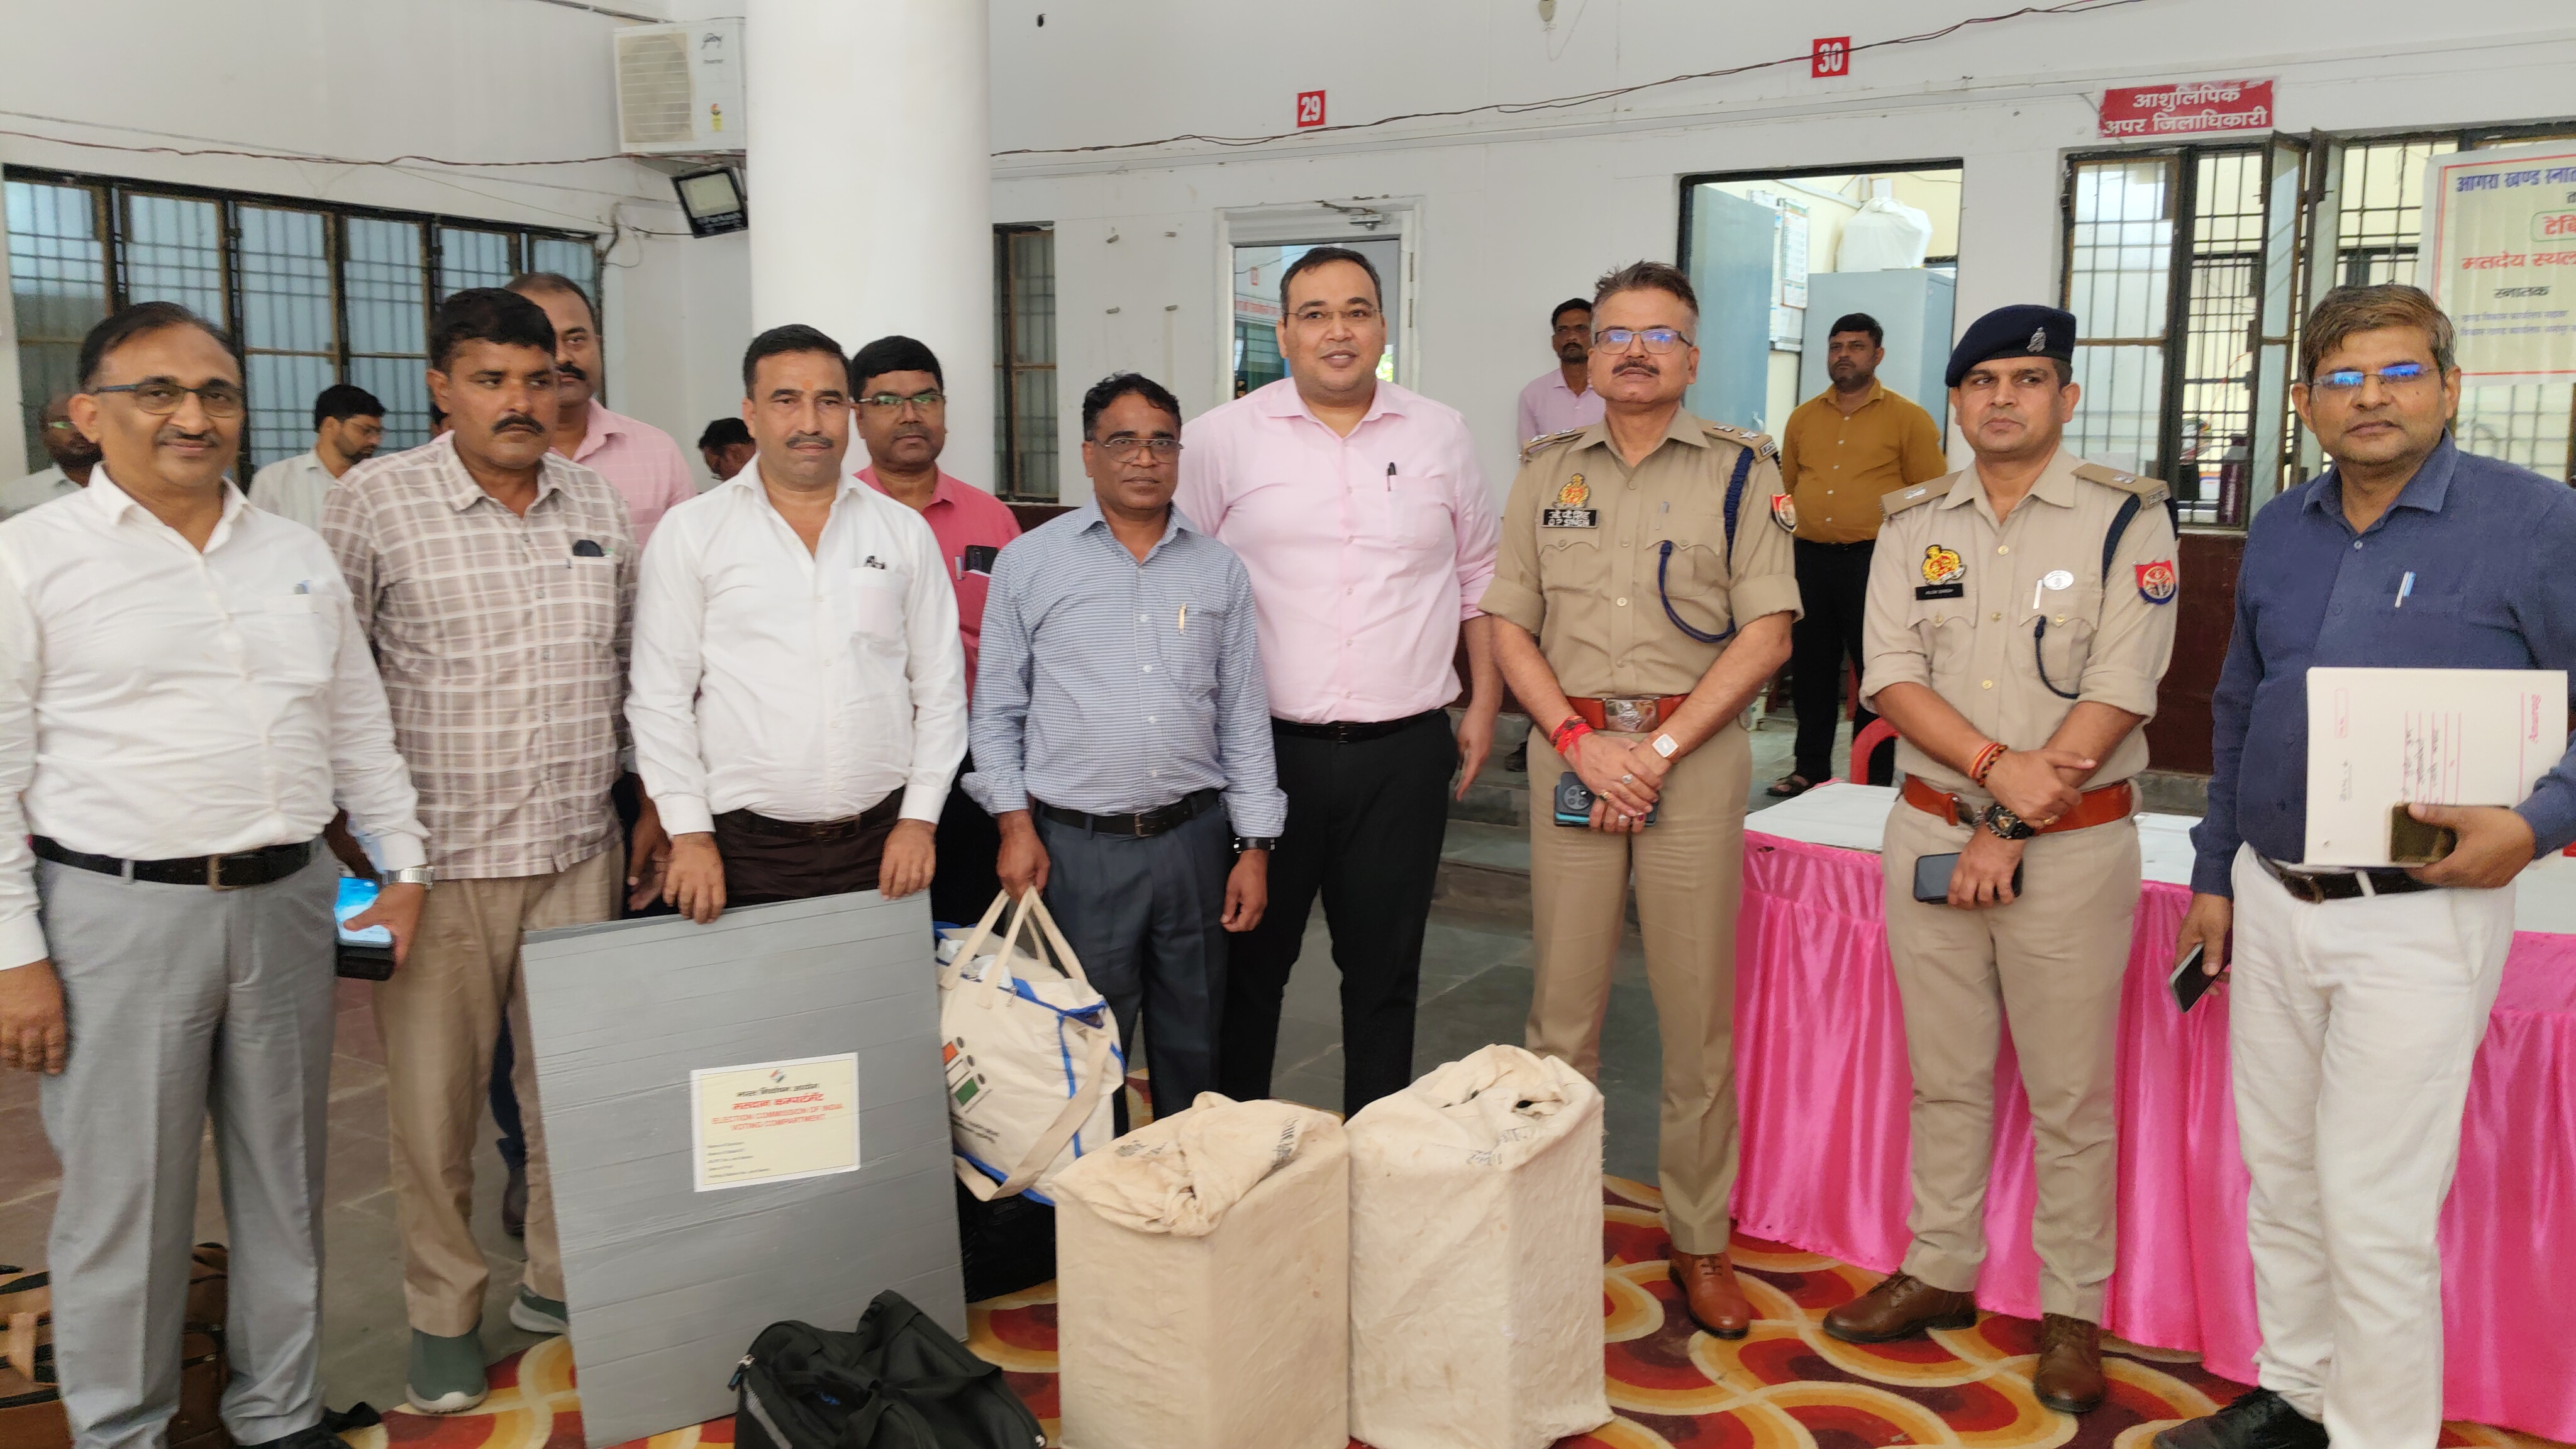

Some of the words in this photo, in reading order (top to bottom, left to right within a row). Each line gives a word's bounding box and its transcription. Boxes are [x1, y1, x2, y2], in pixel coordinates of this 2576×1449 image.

[1818, 42, 1843, 73] 30
[1300, 96, 1321, 121] 29
[2133, 84, 2241, 112] आशुलिपिक
[2104, 118, 2147, 134] अपर
[2152, 106, 2268, 131] जिलाधिकारी
[2456, 174, 2499, 192] आगरा
[2504, 170, 2540, 188] खण्ड
[2461, 250, 2527, 270] मतदेय
[711, 1114, 753, 1124] ELECTION
[755, 1108, 806, 1119] COMMISSION
[731, 1121, 763, 1131] VOTING
[765, 1114, 826, 1126] COMPARTMENT
